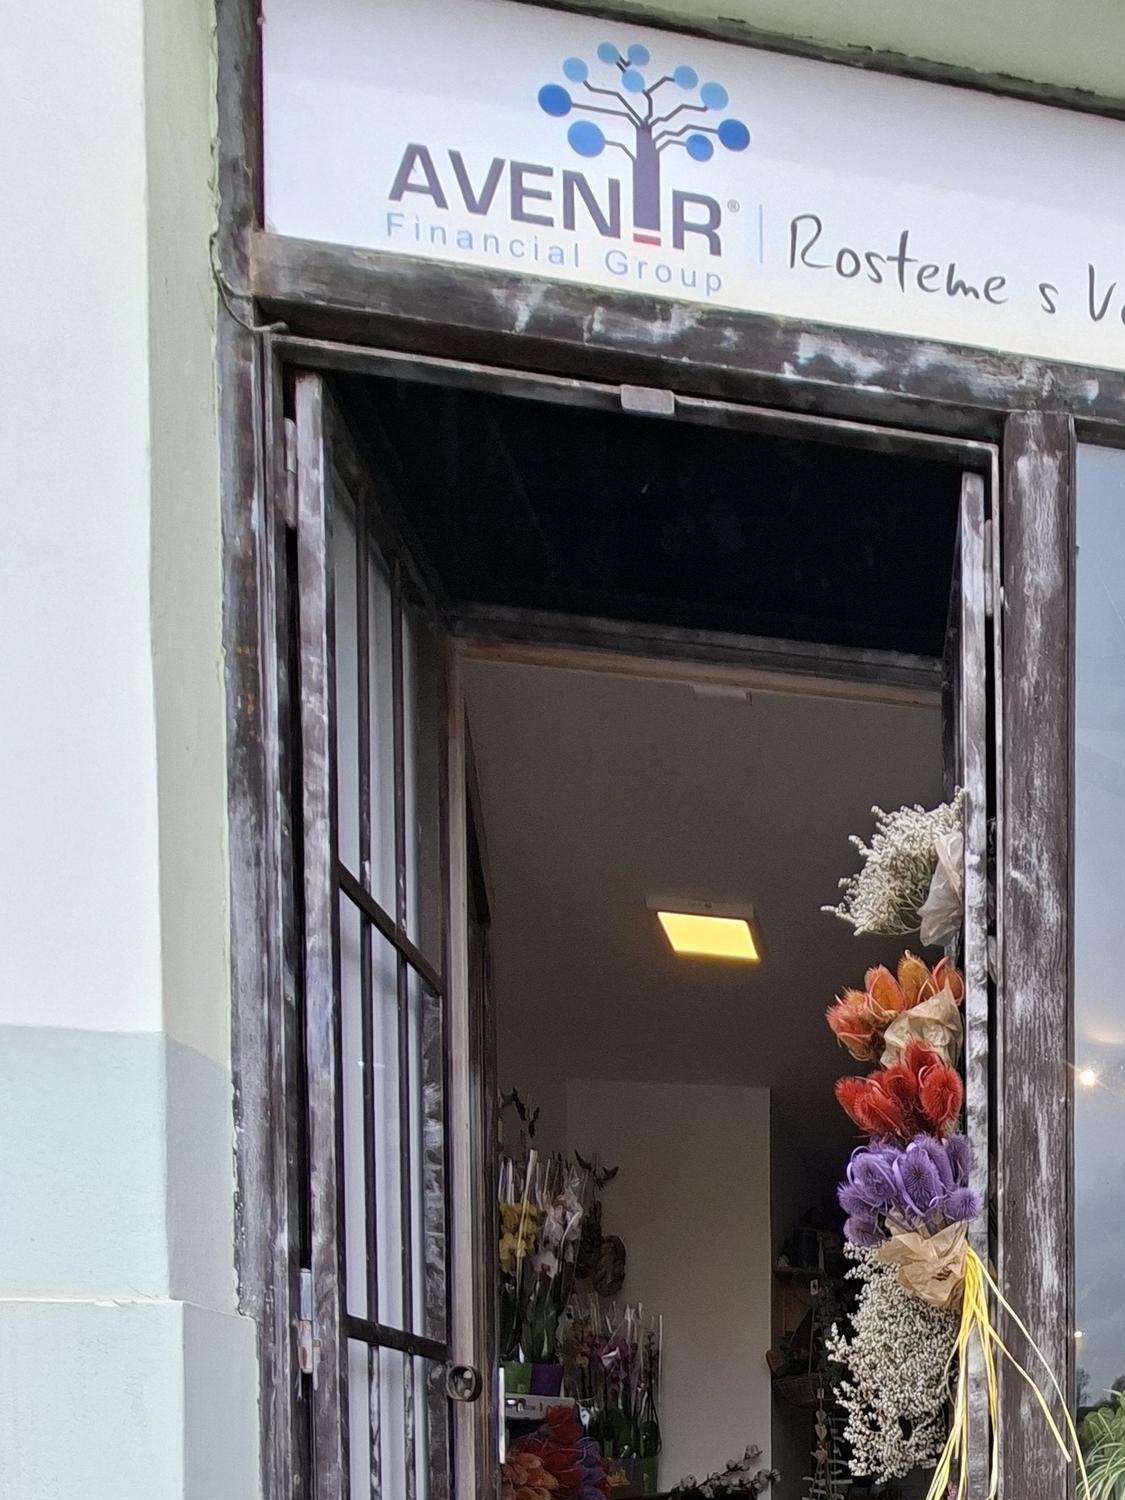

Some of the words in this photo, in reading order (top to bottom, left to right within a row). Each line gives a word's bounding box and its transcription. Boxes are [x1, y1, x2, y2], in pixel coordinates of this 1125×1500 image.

[385, 211, 580, 268] Financial
[604, 249, 723, 297] Group
[789, 213, 1010, 304] Rosteme
[1037, 281, 1059, 315] s
